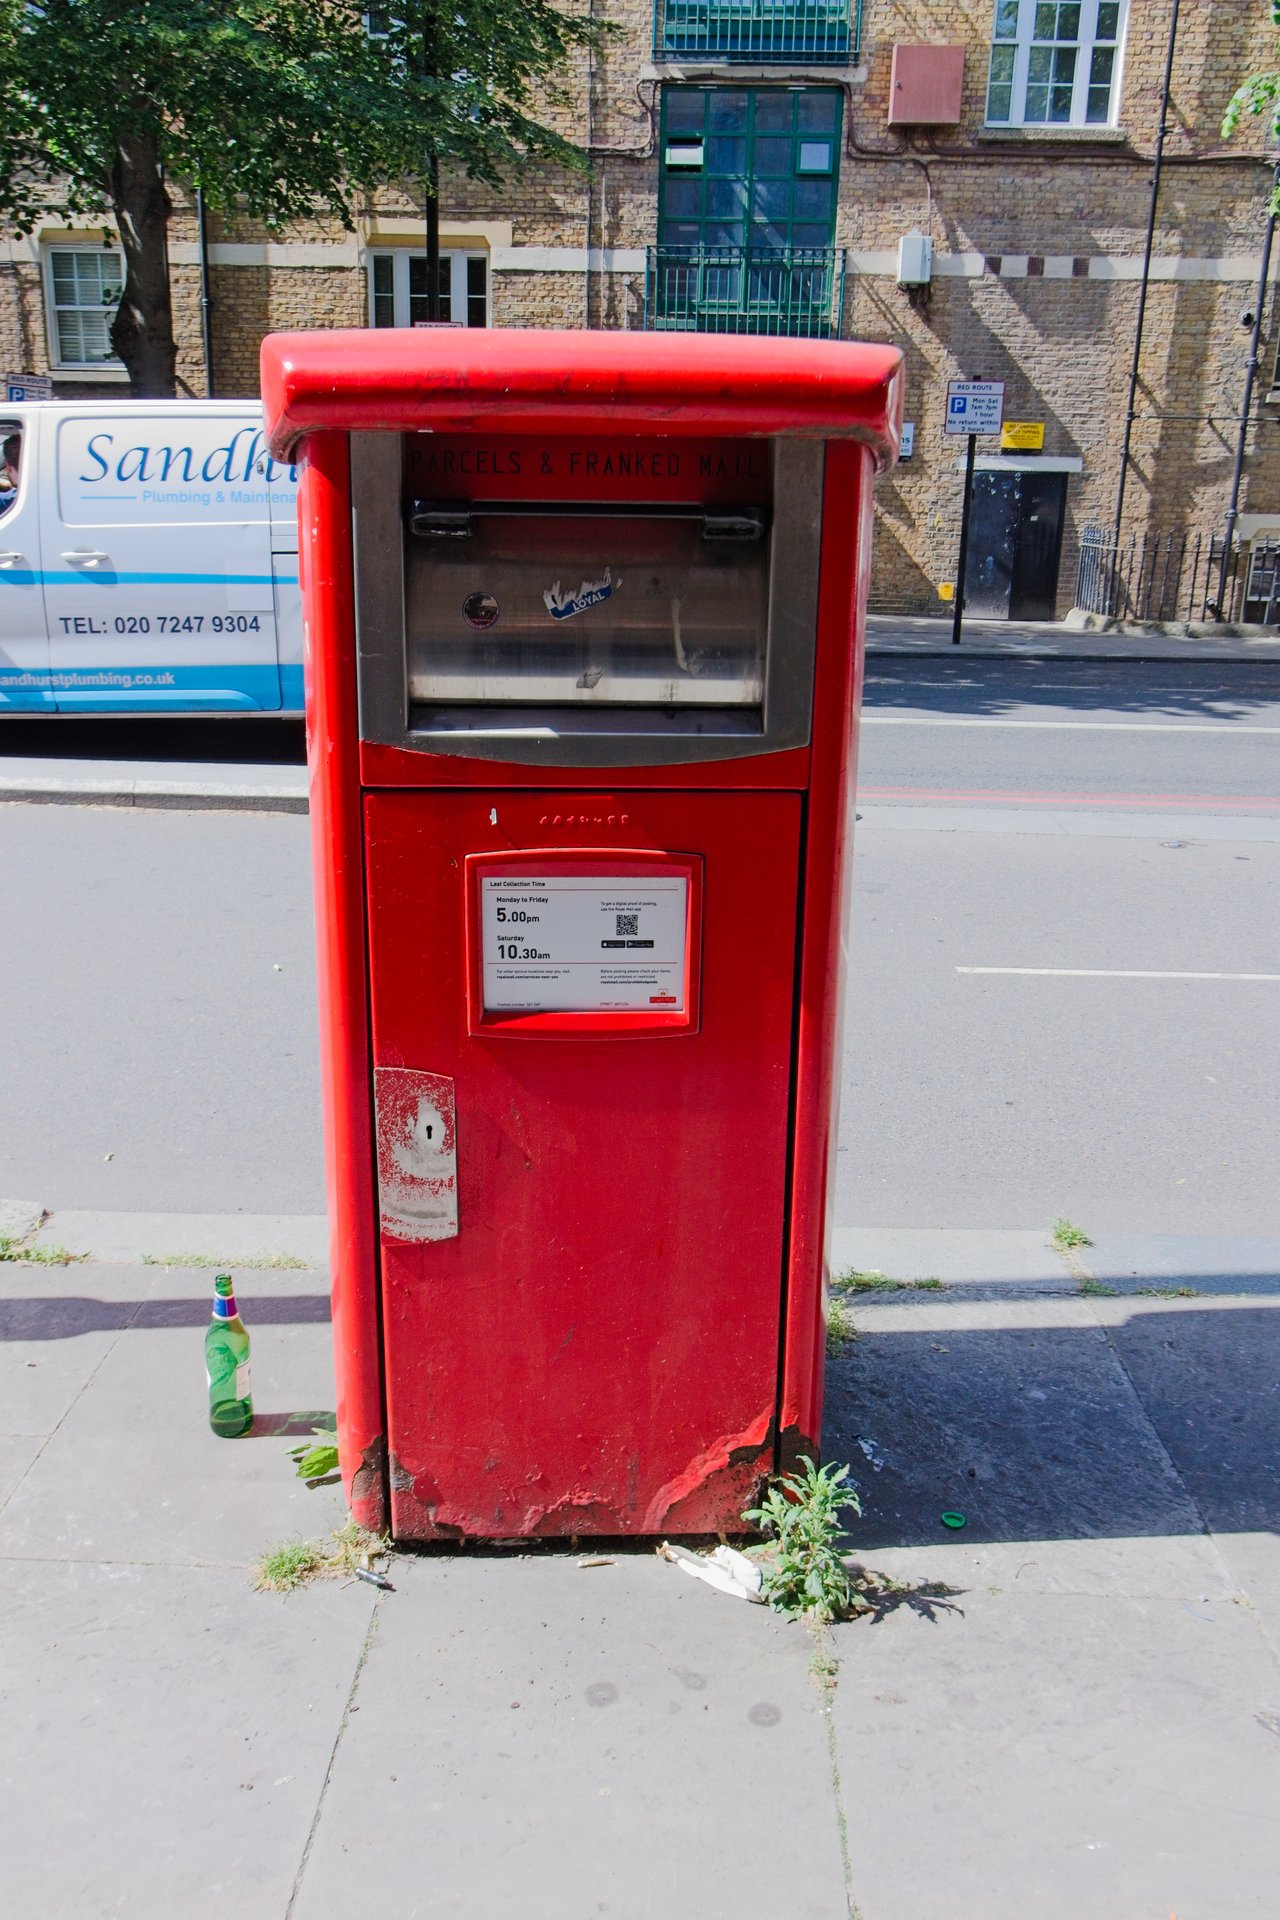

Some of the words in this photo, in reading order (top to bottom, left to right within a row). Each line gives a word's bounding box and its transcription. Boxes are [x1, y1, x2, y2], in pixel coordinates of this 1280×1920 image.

[954, 399, 964, 412] P
[409, 451, 521, 475] PARCELS
[541, 452, 554, 475] &
[570, 452, 680, 477] FRANKED
[699, 453, 759, 478] MAIL
[143, 490, 210, 505] Plumbing
[216, 491, 225, 503] &
[572, 592, 606, 611] LOYAL
[60, 617, 107, 634] TEL:
[115, 617, 150, 633] 020
[157, 616, 203, 633] 7247
[213, 616, 261, 633] 9304
[0, 672, 175, 687] andhurstplumbing.co.uk
[496, 896, 520, 904] Monday
[529, 896, 549, 904] Friday
[496, 907, 540, 924] 5.00pm
[497, 944, 551, 959] 10.30am
